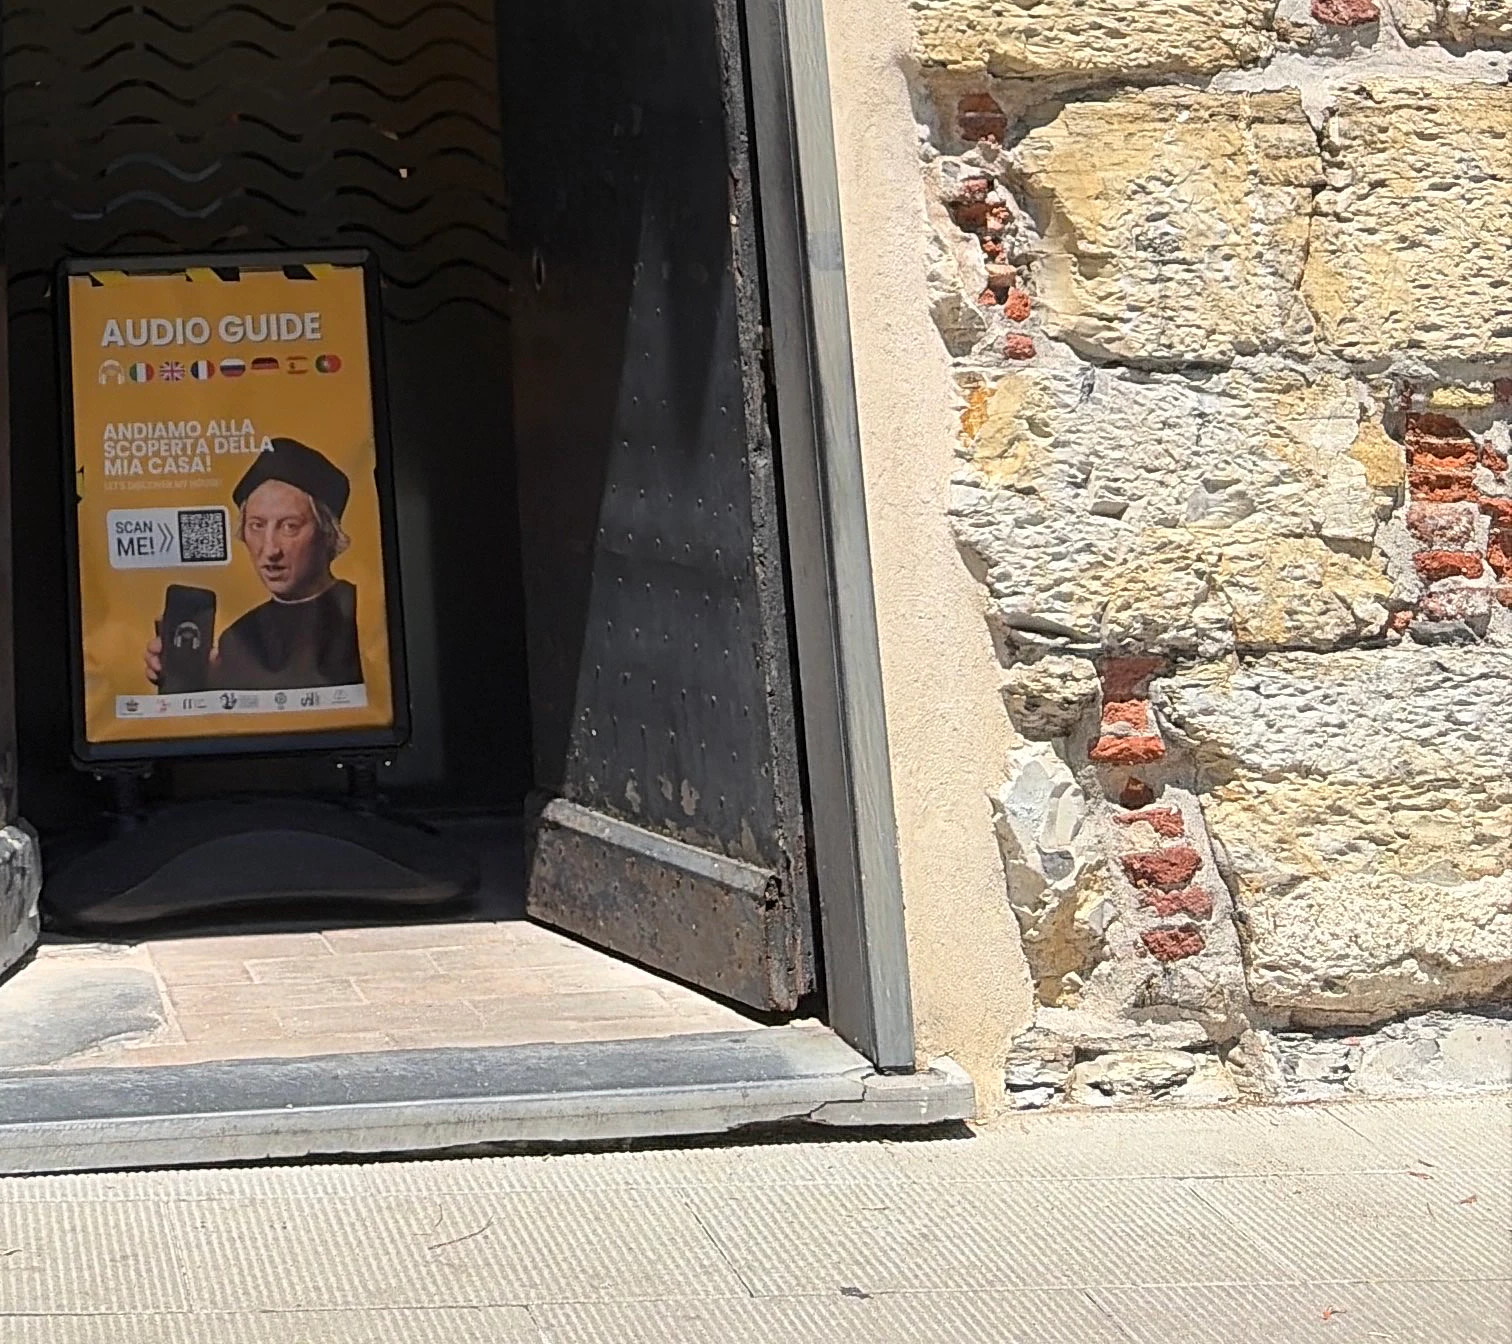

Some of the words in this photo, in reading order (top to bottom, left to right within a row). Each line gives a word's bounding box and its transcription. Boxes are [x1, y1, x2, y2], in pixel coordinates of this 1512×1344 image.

[101, 316, 211, 347] AUDIO
[218, 312, 321, 343] GUIDE
[104, 421, 201, 440] ANDIAMO
[207, 418, 255, 437] ALLA
[104, 438, 210, 458] SCOPERTA
[214, 435, 275, 454] DELLA
[104, 458, 144, 476] MIA
[148, 455, 212, 475] CASA!
[116, 520, 153, 534] SCAN
[117, 536, 155, 557] ME!
